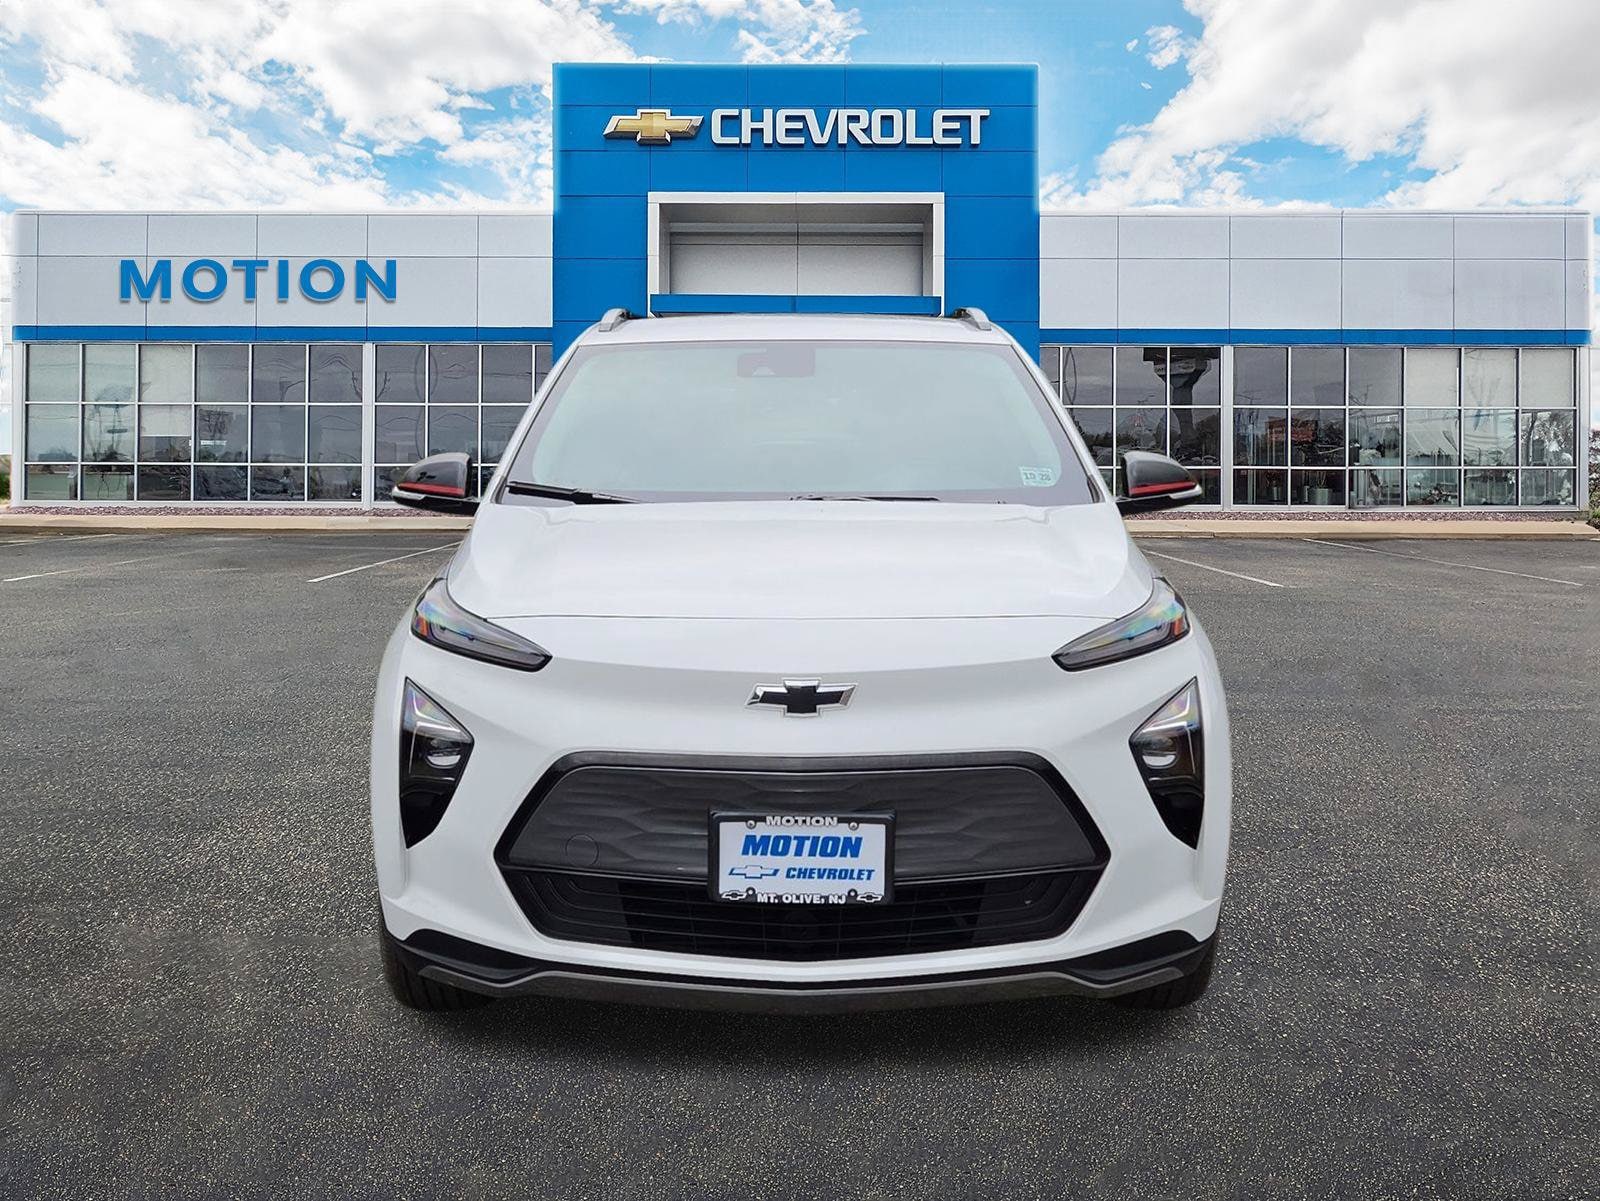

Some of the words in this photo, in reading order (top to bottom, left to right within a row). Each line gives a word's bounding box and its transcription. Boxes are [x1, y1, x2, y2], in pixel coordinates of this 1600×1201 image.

[711, 108, 990, 145] CHEVROLET
[120, 258, 397, 301] MOTION
[766, 816, 838, 827] MOTION
[741, 834, 863, 858] MOTION
[785, 867, 875, 881] CHEVROLET
[757, 893, 779, 904] MT.
[782, 894, 825, 905] OLIVE,
[828, 895, 847, 905] NJ
